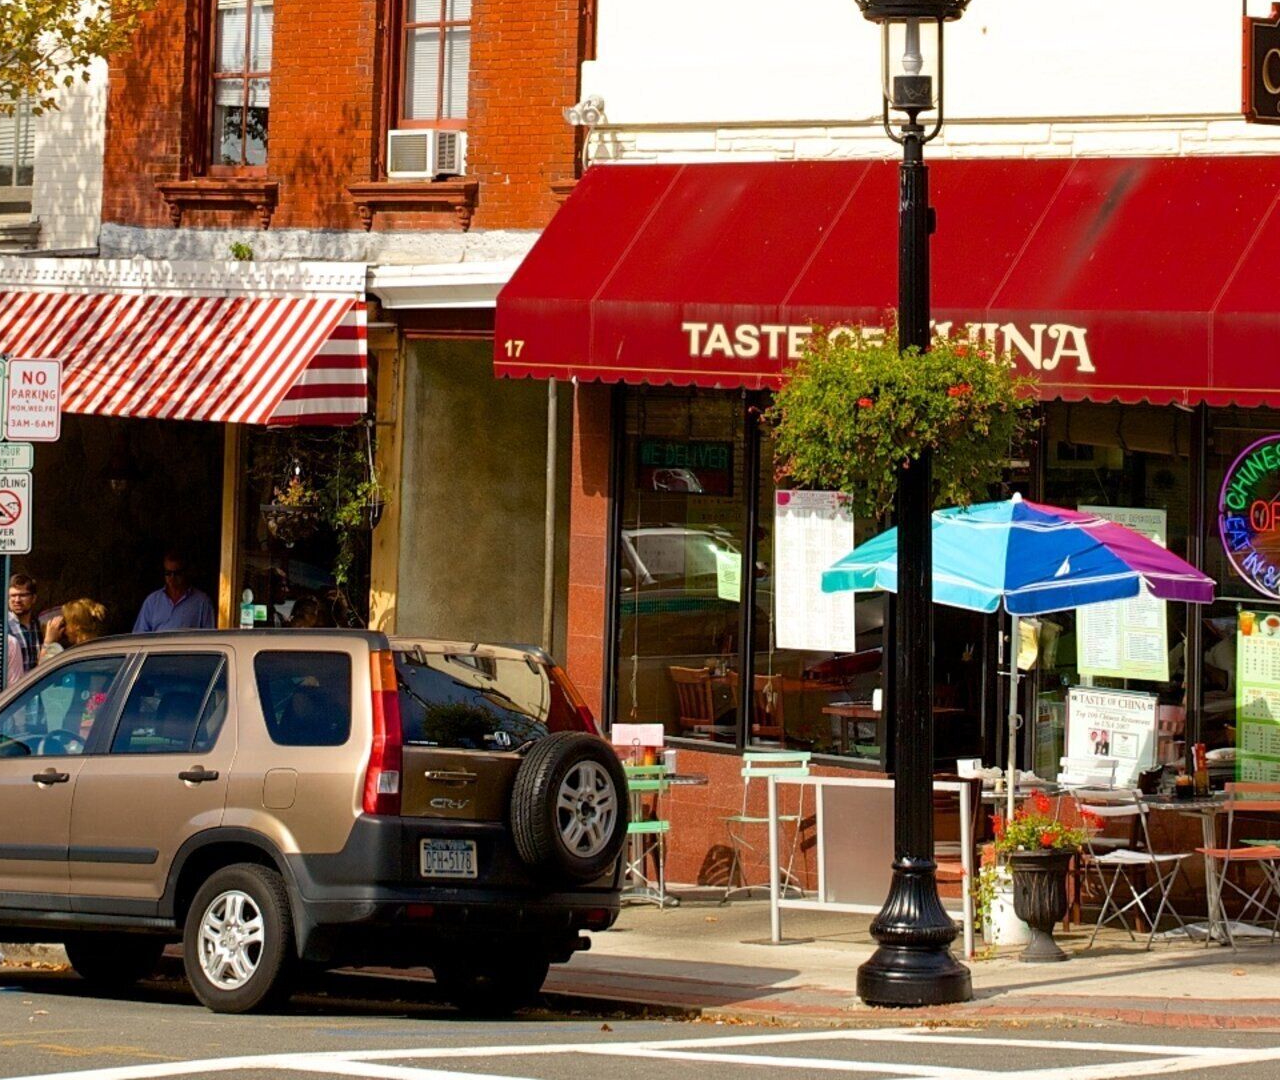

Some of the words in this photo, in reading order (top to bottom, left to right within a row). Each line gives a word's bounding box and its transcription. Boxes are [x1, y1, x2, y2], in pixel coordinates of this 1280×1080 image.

[681, 322, 813, 359] TASTE
[504, 340, 524, 358] 17
[22, 371, 47, 386] NO
[11, 389, 56, 399] PARKING
[11, 420, 54, 428] 3AM-6AM
[1, 448, 20, 456] HOUR
[666, 442, 729, 469] DELIVER
[0, 539, 16, 547] MIN
[1226, 516, 1250, 551] EAT
[1242, 551, 1266, 575] IN
[1263, 565, 1277, 588] &
[1080, 695, 1106, 705] TASTE
[1108, 697, 1116, 706] OF
[1118, 699, 1146, 711] CHINA
